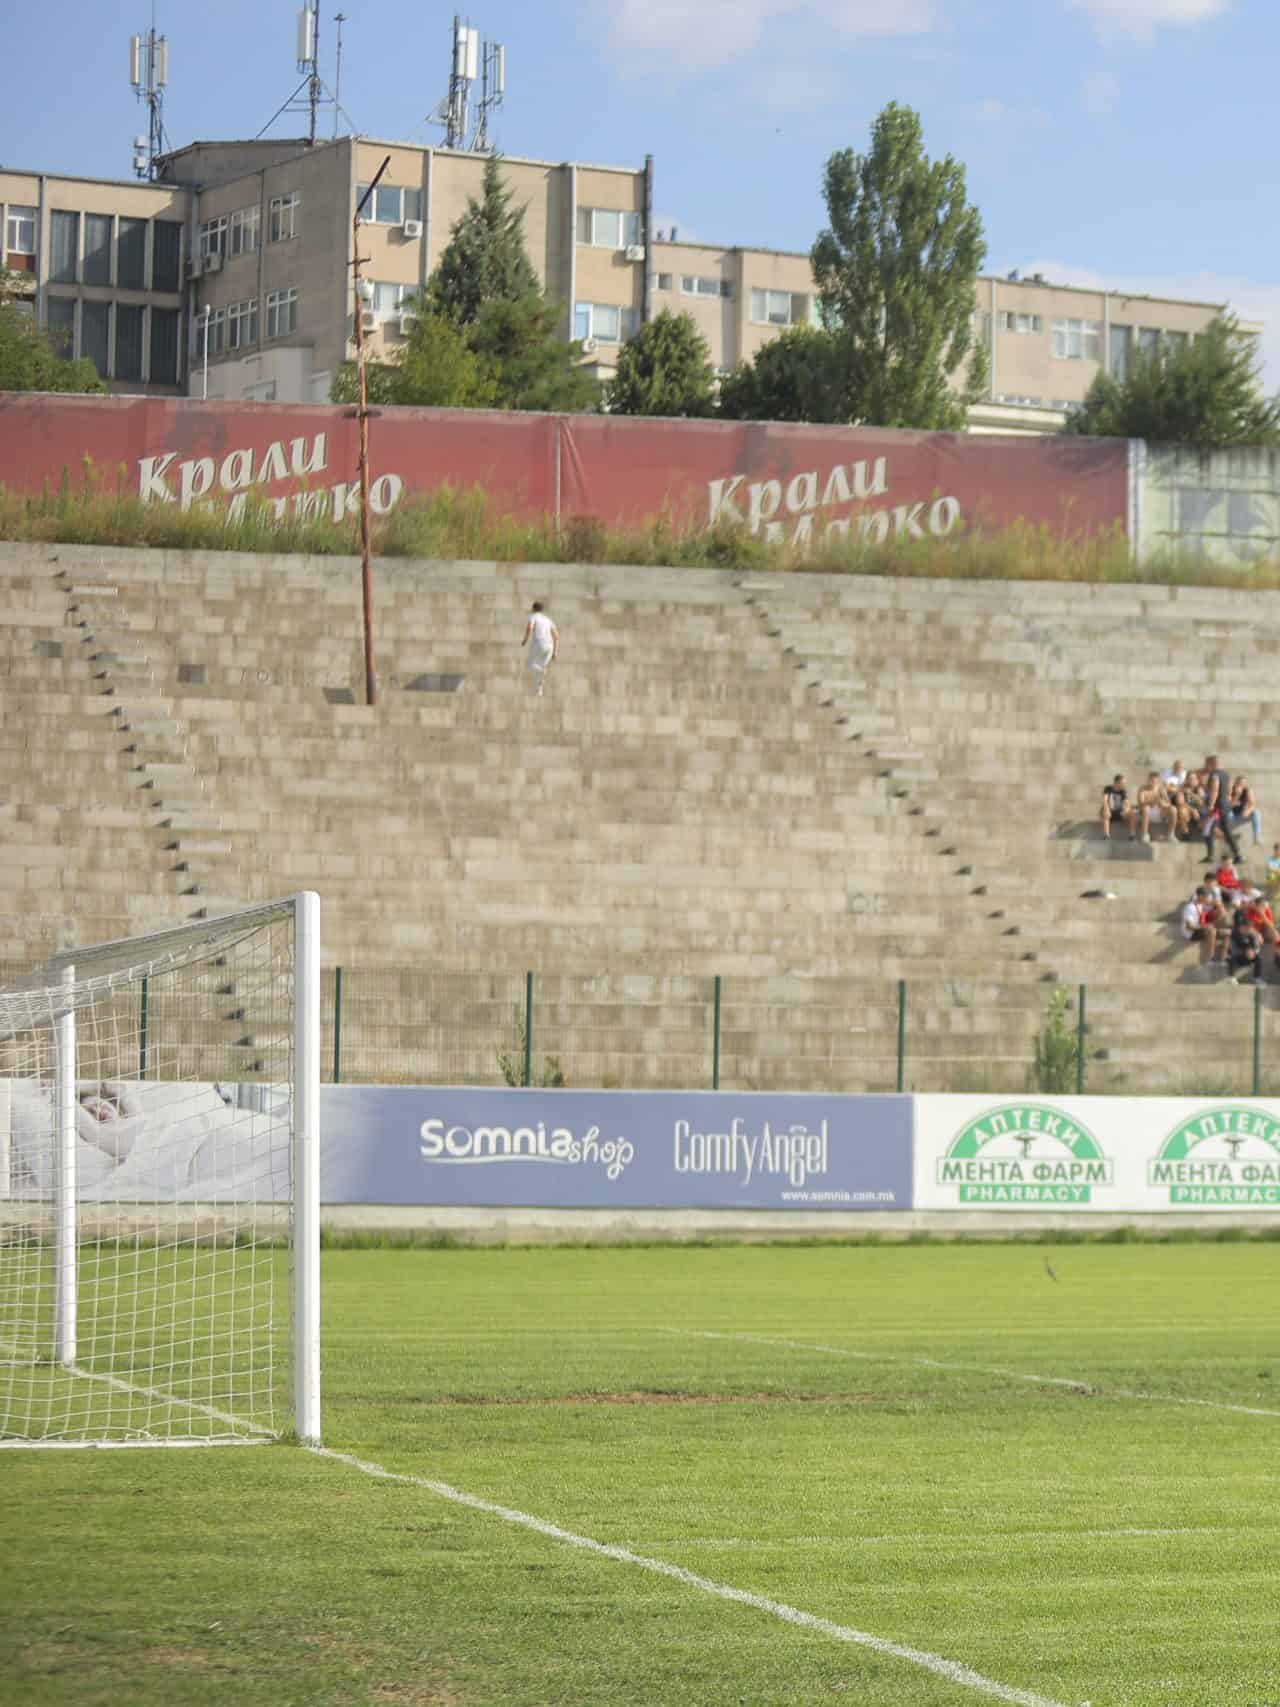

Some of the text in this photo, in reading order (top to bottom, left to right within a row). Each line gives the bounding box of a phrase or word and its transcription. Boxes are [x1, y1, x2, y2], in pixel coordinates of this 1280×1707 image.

[137, 432, 328, 514] Крали
[707, 456, 888, 535] Крали
[973, 1109, 1081, 1148] АПТЕКИ
[942, 1161, 1107, 1182] МЕНТА ФАРМ
[1153, 1162, 1233, 1182] МЕНТА
[966, 1186, 1083, 1201] PHARMACY
